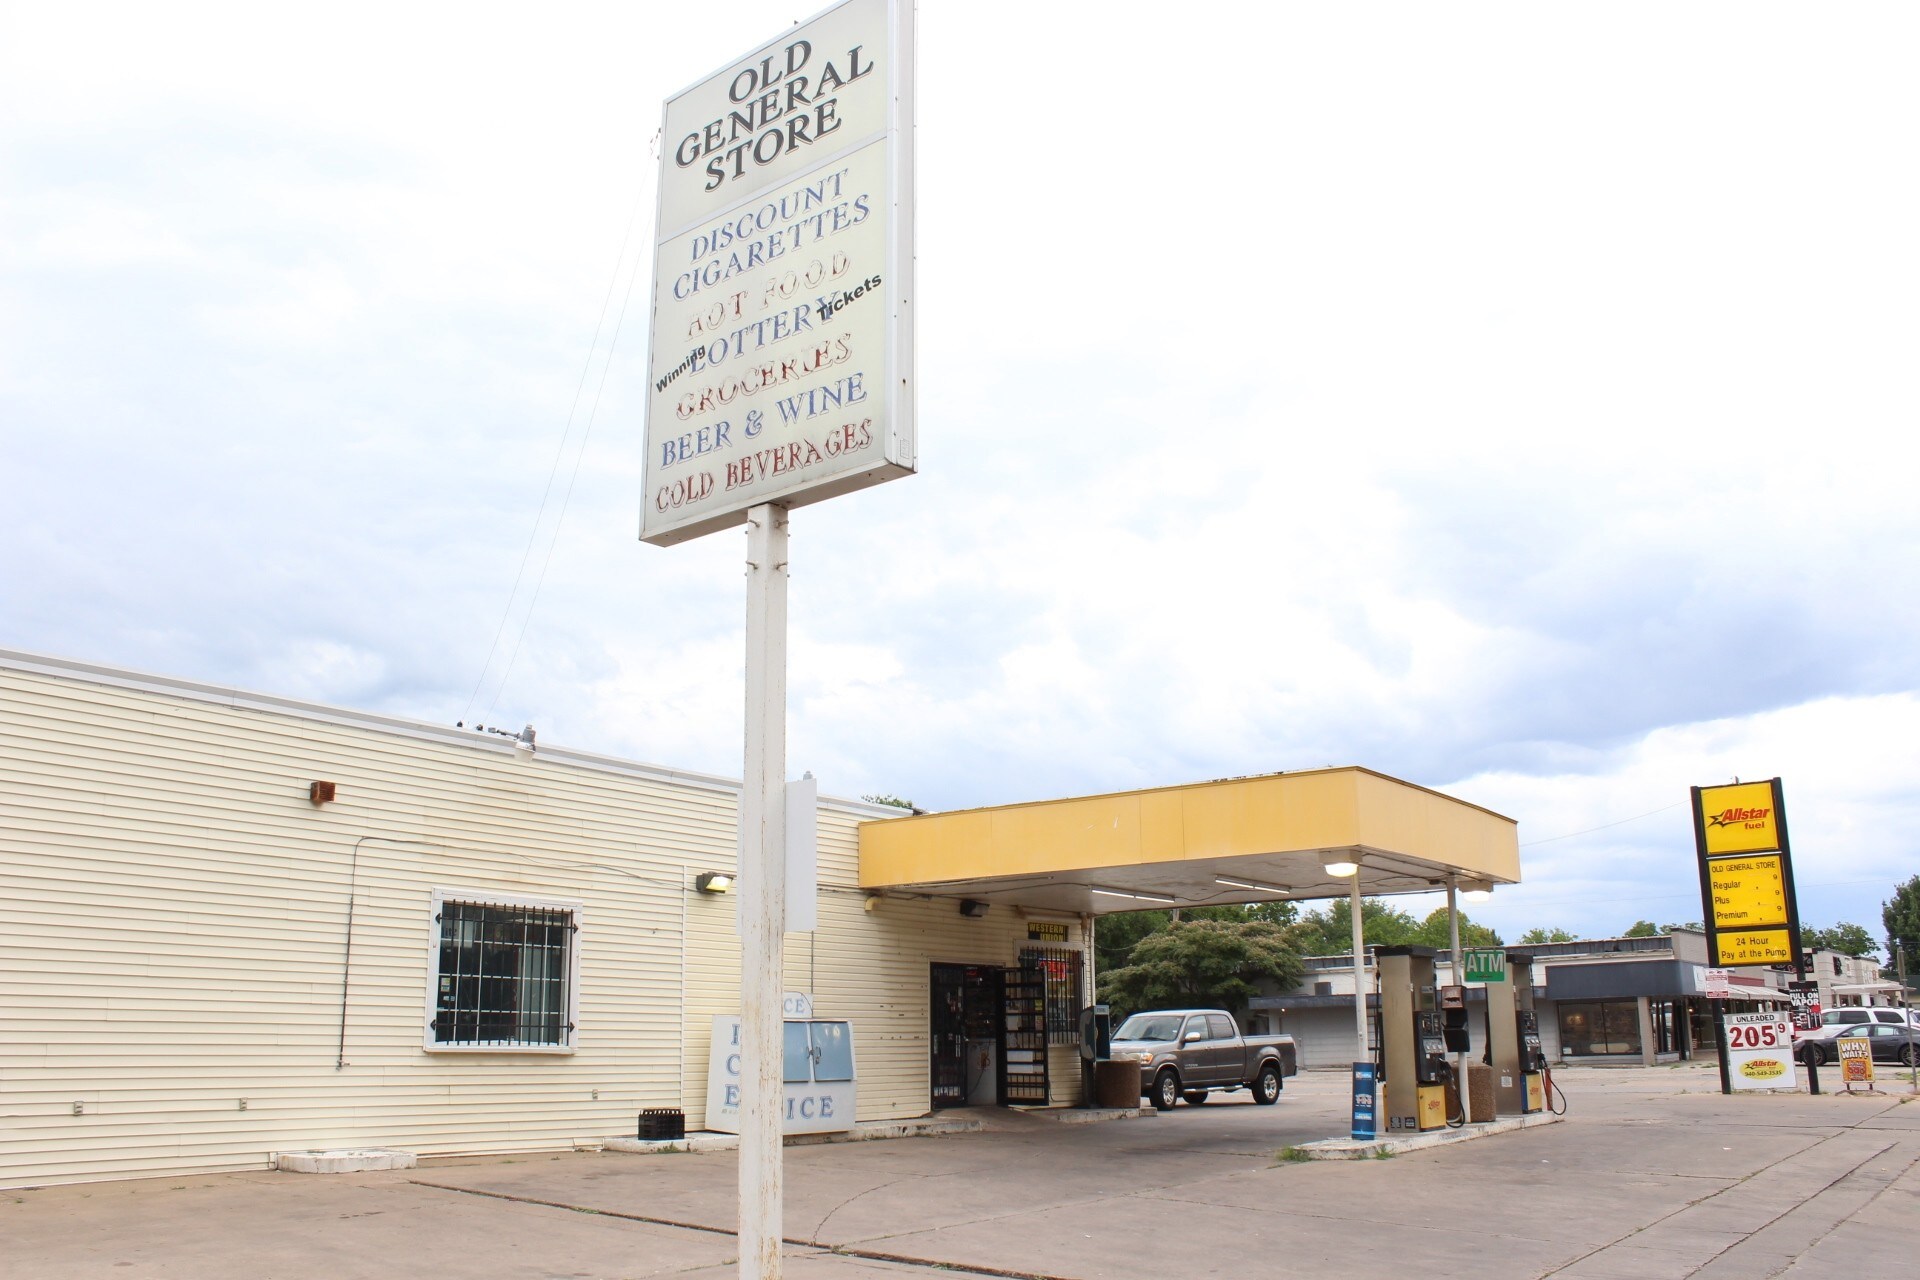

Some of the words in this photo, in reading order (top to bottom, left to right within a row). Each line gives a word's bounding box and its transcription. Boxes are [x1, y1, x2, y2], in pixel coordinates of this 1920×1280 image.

[729, 40, 812, 104] OLD
[675, 45, 874, 168] GENERAL
[705, 98, 842, 192] STORE
[690, 168, 849, 264] DISCOUNT
[673, 194, 870, 302] CIGARETTES
[684, 290, 748, 342] HOT
[759, 249, 851, 310] FOOD
[816, 273, 882, 322] Tickets
[689, 290, 840, 377] LOTTERY
[655, 344, 706, 393] Winning
[676, 332, 852, 420] GROCERIES
[660, 420, 732, 470] BEER
[744, 409, 763, 439] &
[775, 372, 867, 428] WINE
[656, 471, 715, 514] COLD
[725, 418, 873, 491] BEVERAGES
[1721, 807, 1771, 822] Allstar
[1744, 821, 1765, 829] fuel
[1711, 865, 1724, 873] OLD
[1726, 863, 1753, 871] GENERAL
[1756, 861, 1776, 869] STORE
[1713, 881, 1741, 890] Regular
[1715, 896, 1730, 904] Plus
[1716, 911, 1748, 919] Premium
[1028, 923, 1064, 933] WESTERN
[1736, 938, 1746, 946] 24
[1749, 937, 1769, 945] Hour
[1466, 953, 1504, 973] ATM
[1721, 951, 1735, 960] Pay
[1738, 950, 1746, 958] at
[1749, 949, 1762, 957] the
[1765, 949, 1787, 957] Pump
[1790, 992, 1807, 1000] FULL
[1790, 999, 1820, 1007] VAPOR
[1729, 1025, 1776, 1048] 205
[1777, 1023, 1786, 1033] 9
[1840, 1042, 1867, 1051] WHY
[1841, 1050, 1869, 1059] WAIT?
[786, 1096, 834, 1120] ICE
